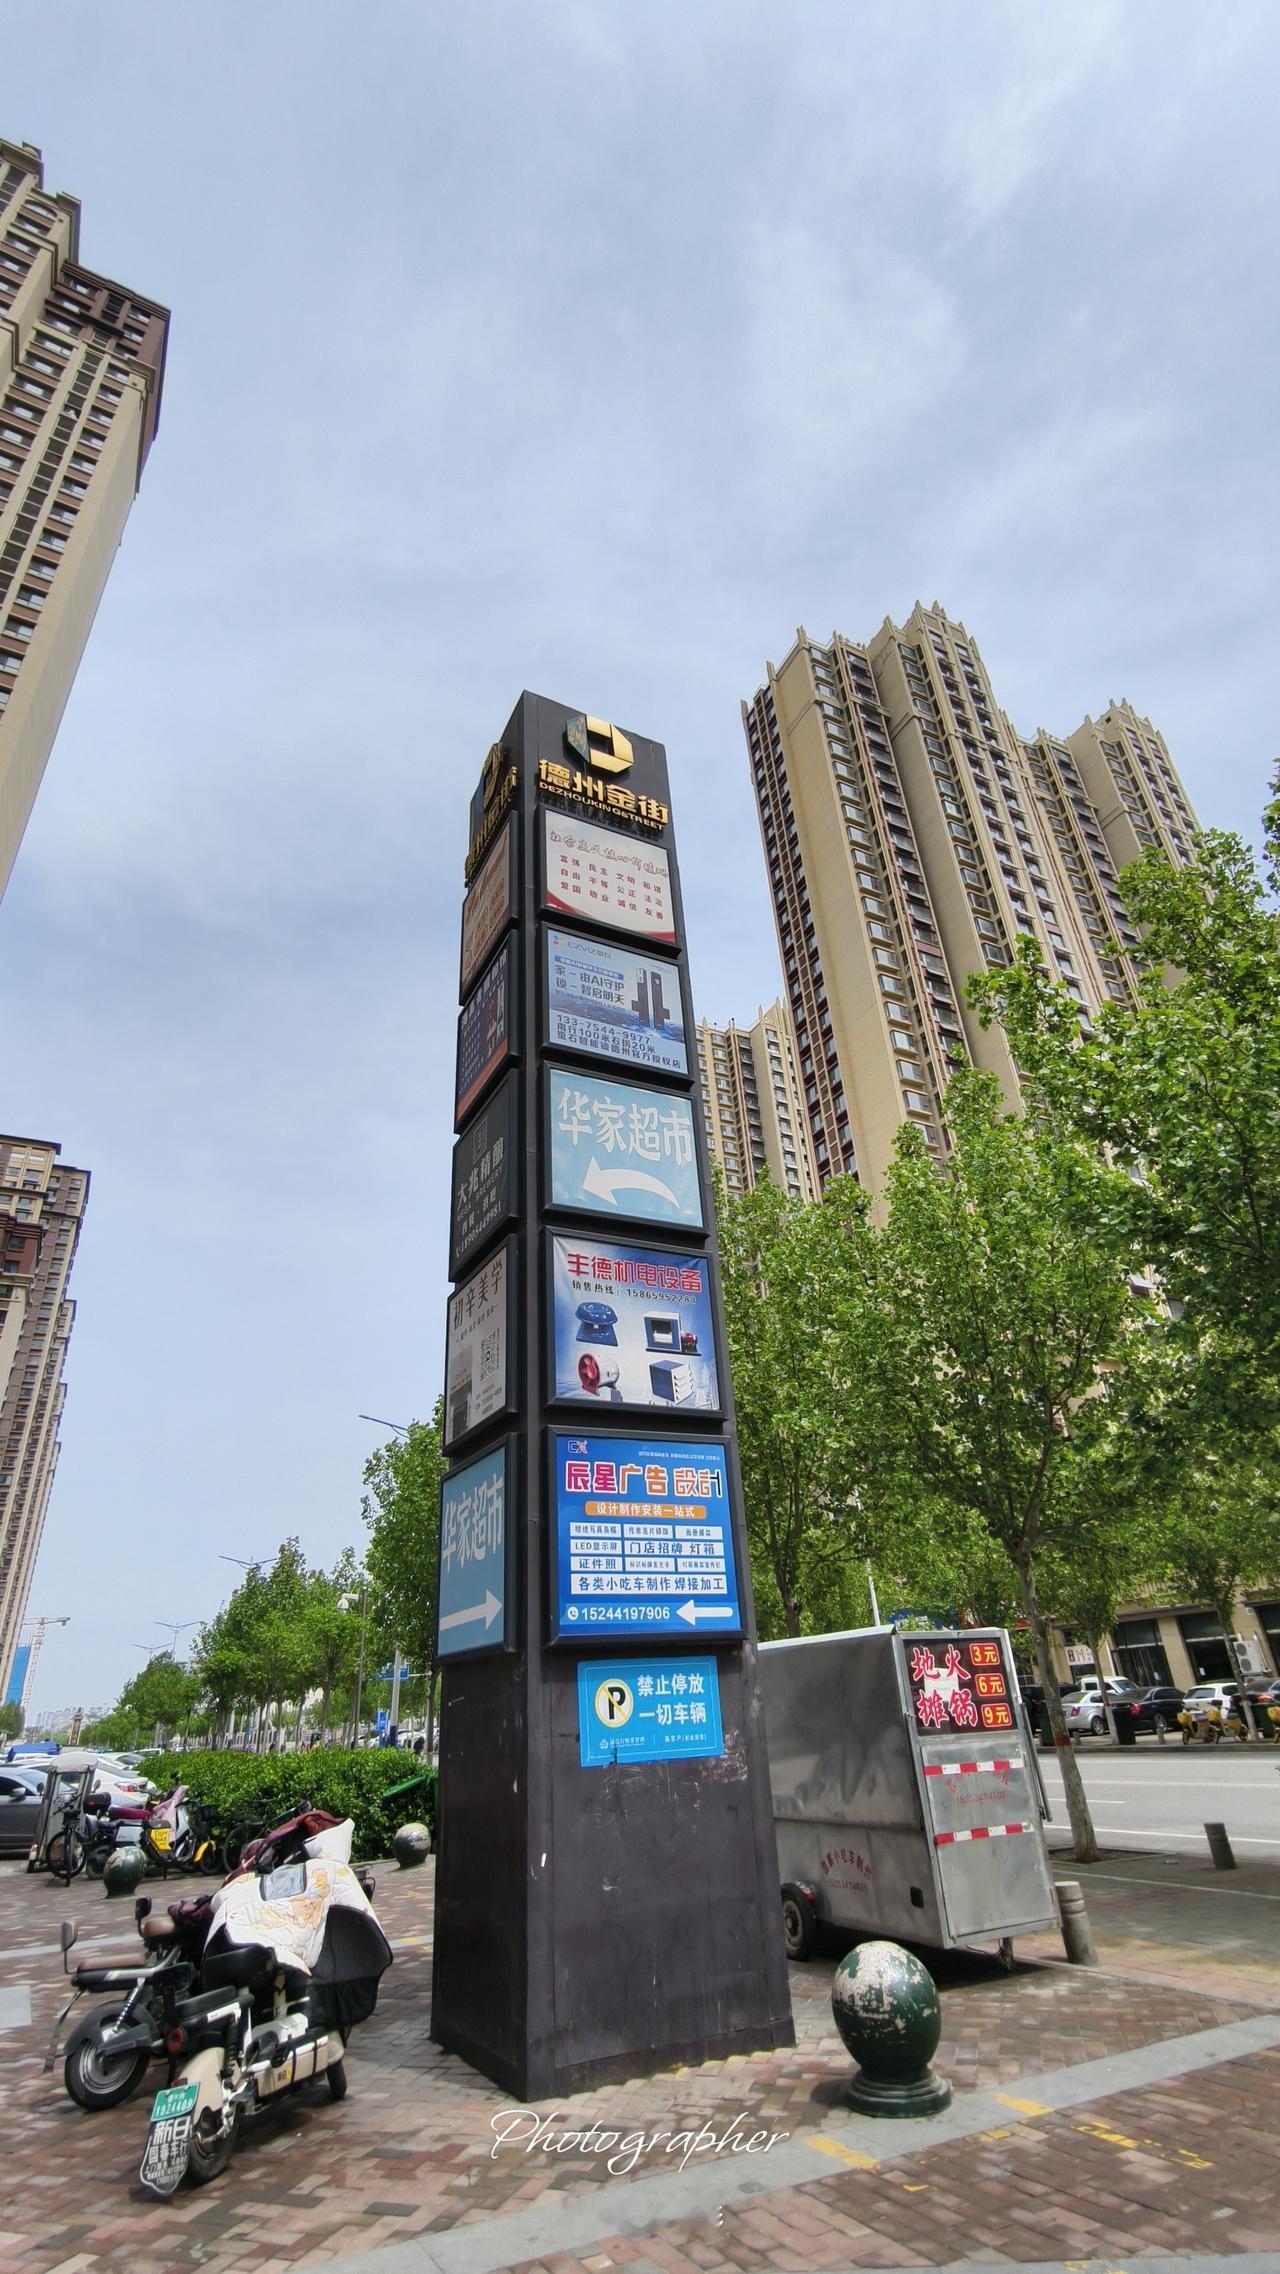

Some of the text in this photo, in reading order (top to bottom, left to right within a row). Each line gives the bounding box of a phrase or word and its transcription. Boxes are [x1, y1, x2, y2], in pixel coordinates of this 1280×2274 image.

[539, 758, 670, 824] 德州金街
[560, 868, 581, 881] 自由
[588, 877, 609, 889] 平等
[616, 886, 637, 898] 公正
[588, 863, 609, 876] 民主
[616, 872, 636, 885] 文明
[560, 881, 582, 894] 爱国
[558, 1087, 693, 1166] 华家超市
[567, 1251, 702, 1293] 丰德机电设备
[565, 1460, 668, 1496] 辰星广告
[596, 1503, 695, 1519] 设计制作安装一站式
[443, 1473, 504, 1574] 华家超市
[629, 1541, 715, 1555] 门店招牌 灯箱
[578, 1558, 617, 1570] 证件照
[578, 1576, 724, 1592] 各类小吃车制作 焊接加工
[582, 1606, 670, 1621] 15244197906
[911, 1643, 971, 1682] 地火
[973, 1646, 998, 1663] 3元
[637, 1673, 704, 1697] 禁止停放
[978, 1676, 1003, 1693] 6元
[639, 1702, 707, 1726] 一切车辆
[984, 1706, 1010, 1724] 9元
[153, 2116, 191, 2145] 新日
